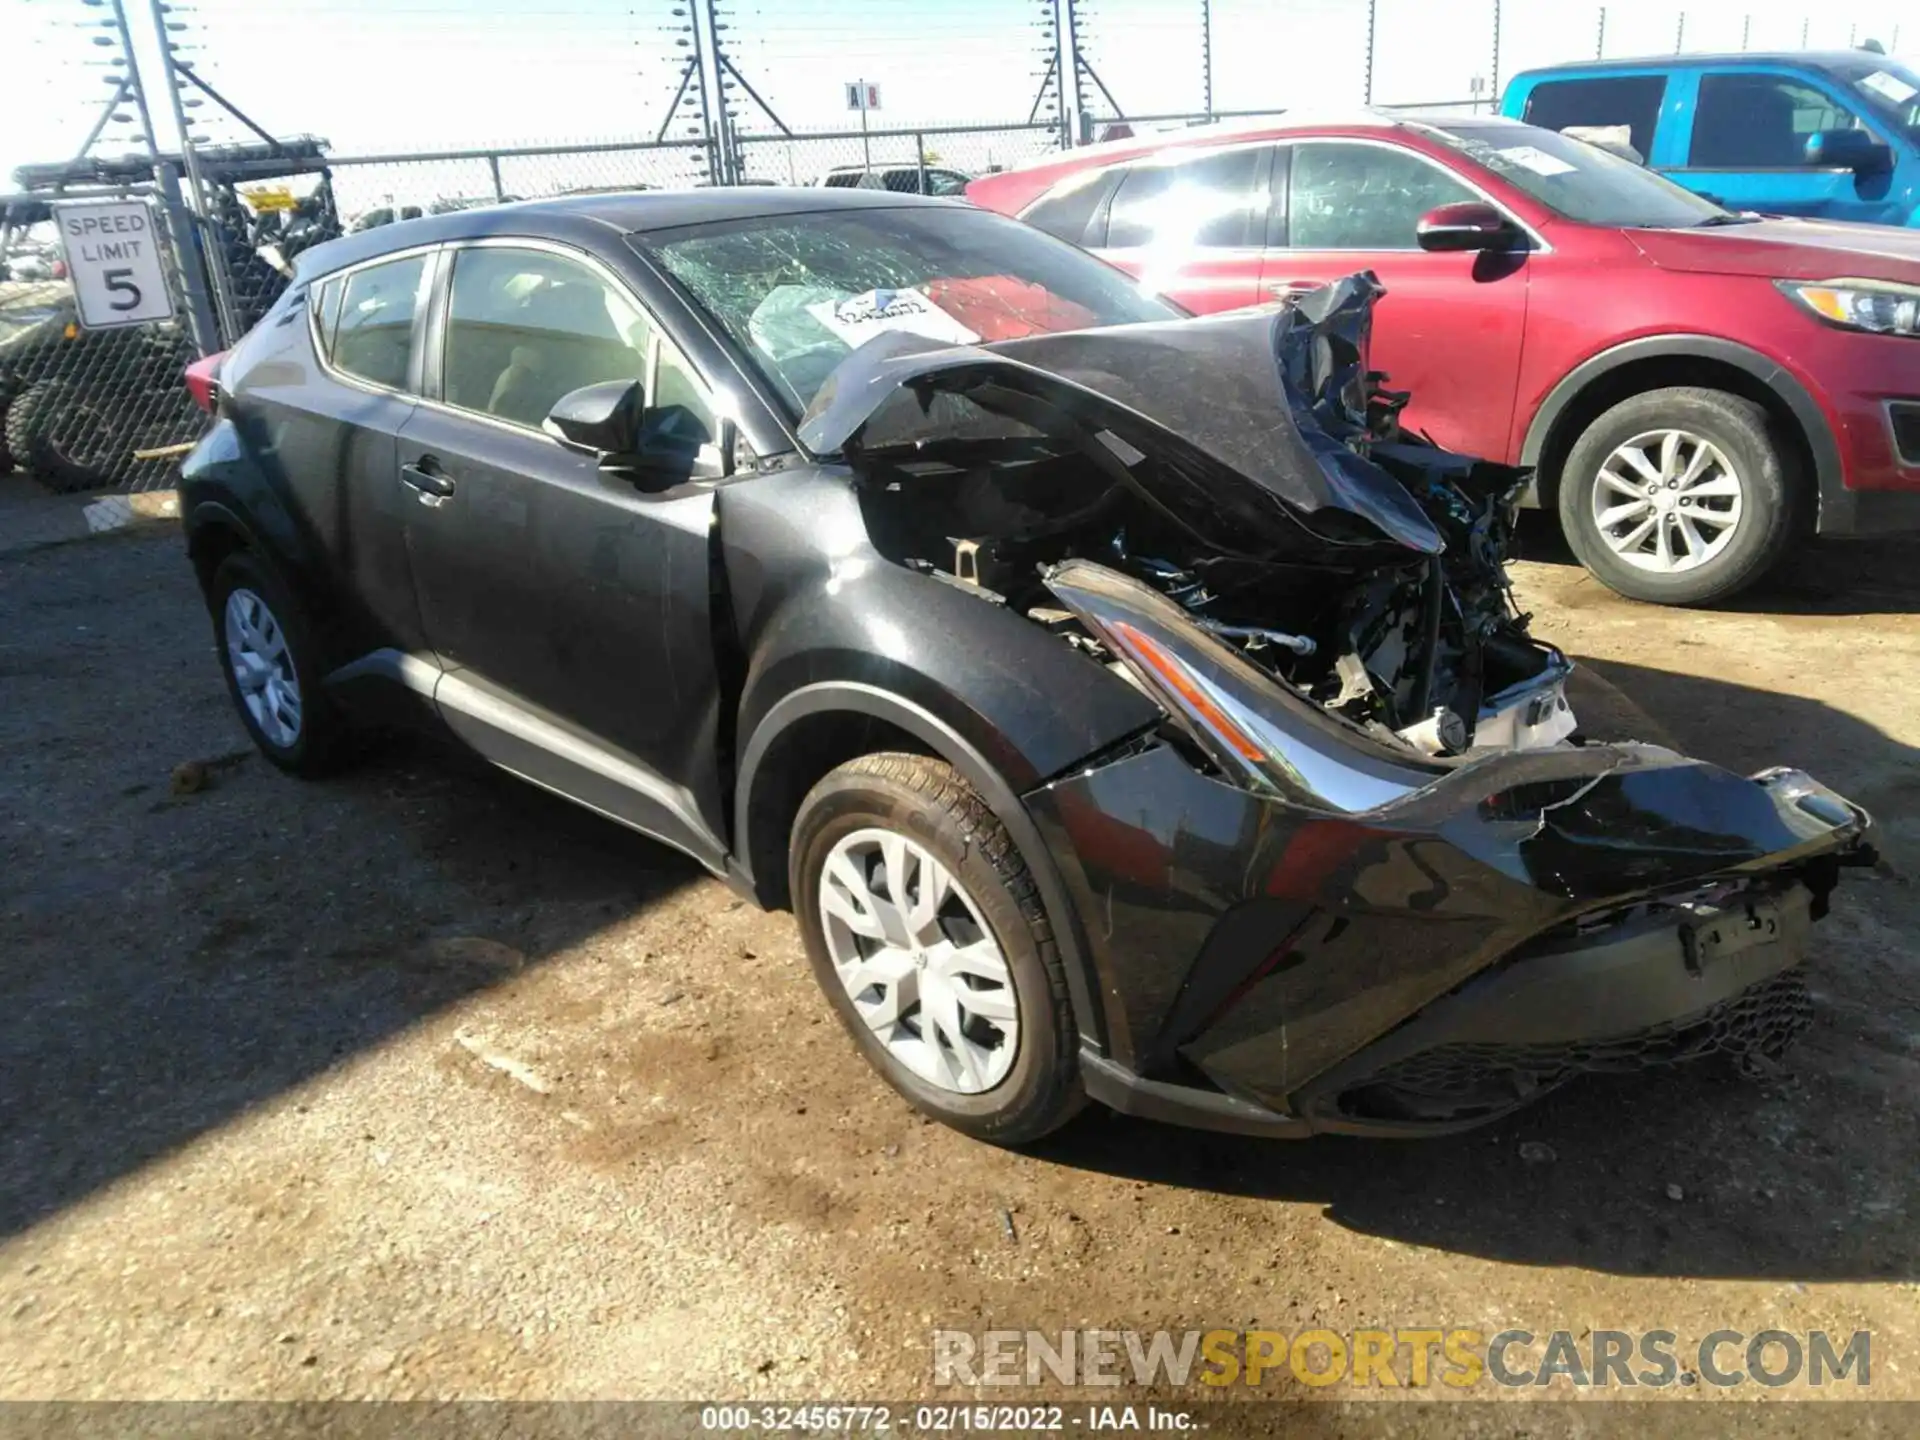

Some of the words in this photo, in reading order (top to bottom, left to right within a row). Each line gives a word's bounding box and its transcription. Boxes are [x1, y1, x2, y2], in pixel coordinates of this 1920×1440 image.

[851, 86, 859, 107] A
[68, 215, 145, 236] SPEED
[82, 240, 141, 261] LIMIT
[103, 267, 141, 311] 5
